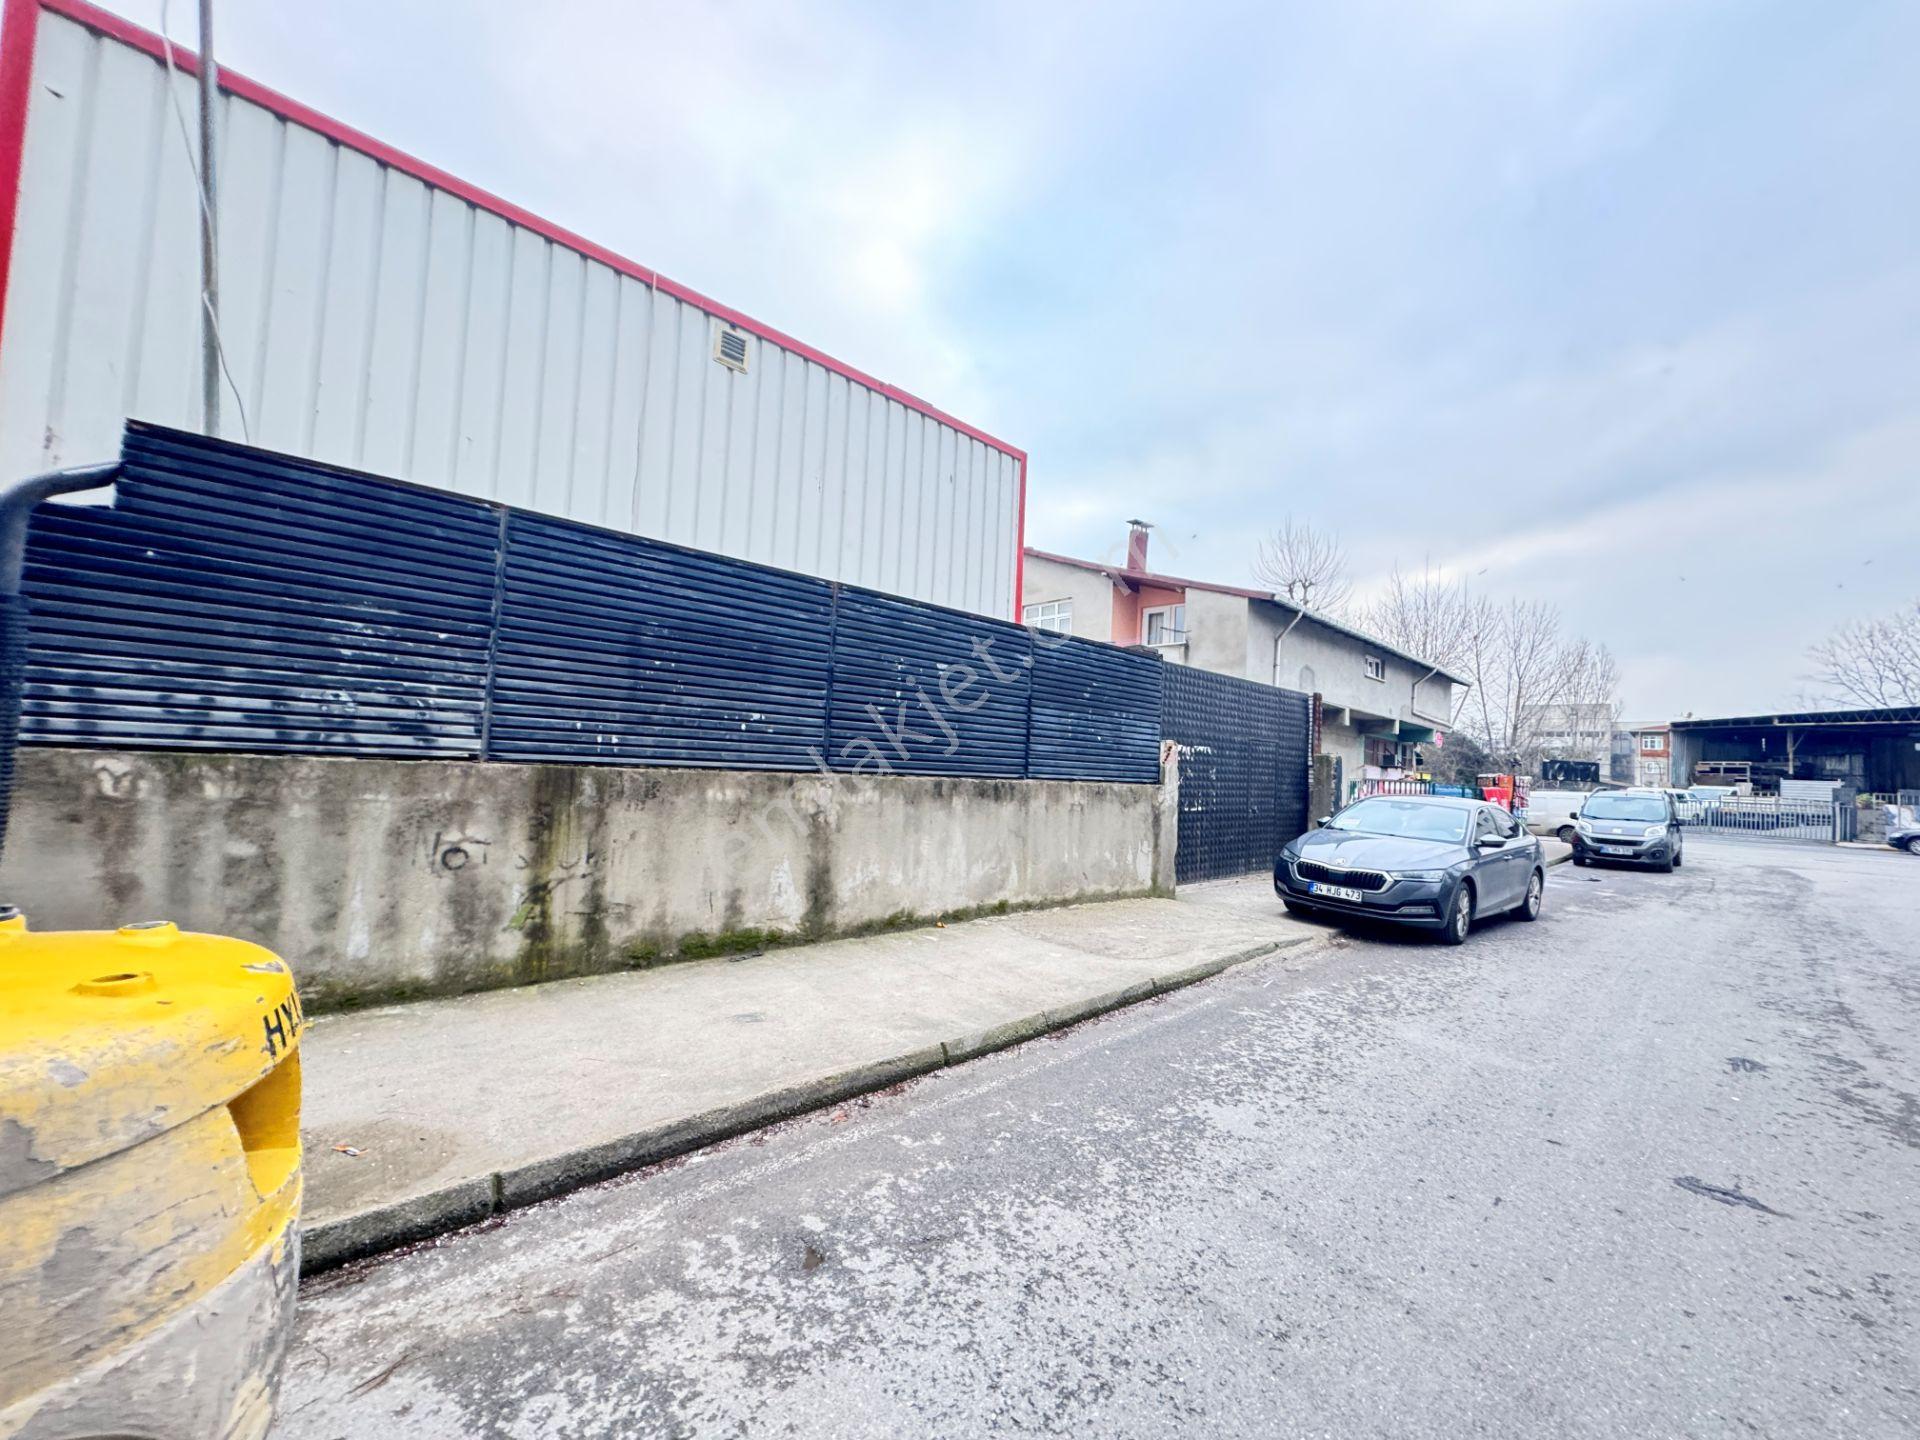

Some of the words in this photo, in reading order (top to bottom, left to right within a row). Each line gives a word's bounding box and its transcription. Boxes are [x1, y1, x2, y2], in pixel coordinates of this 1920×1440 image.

[1313, 884, 1323, 893] 34
[1326, 885, 1341, 897] HJG
[1345, 889, 1361, 900] 473
